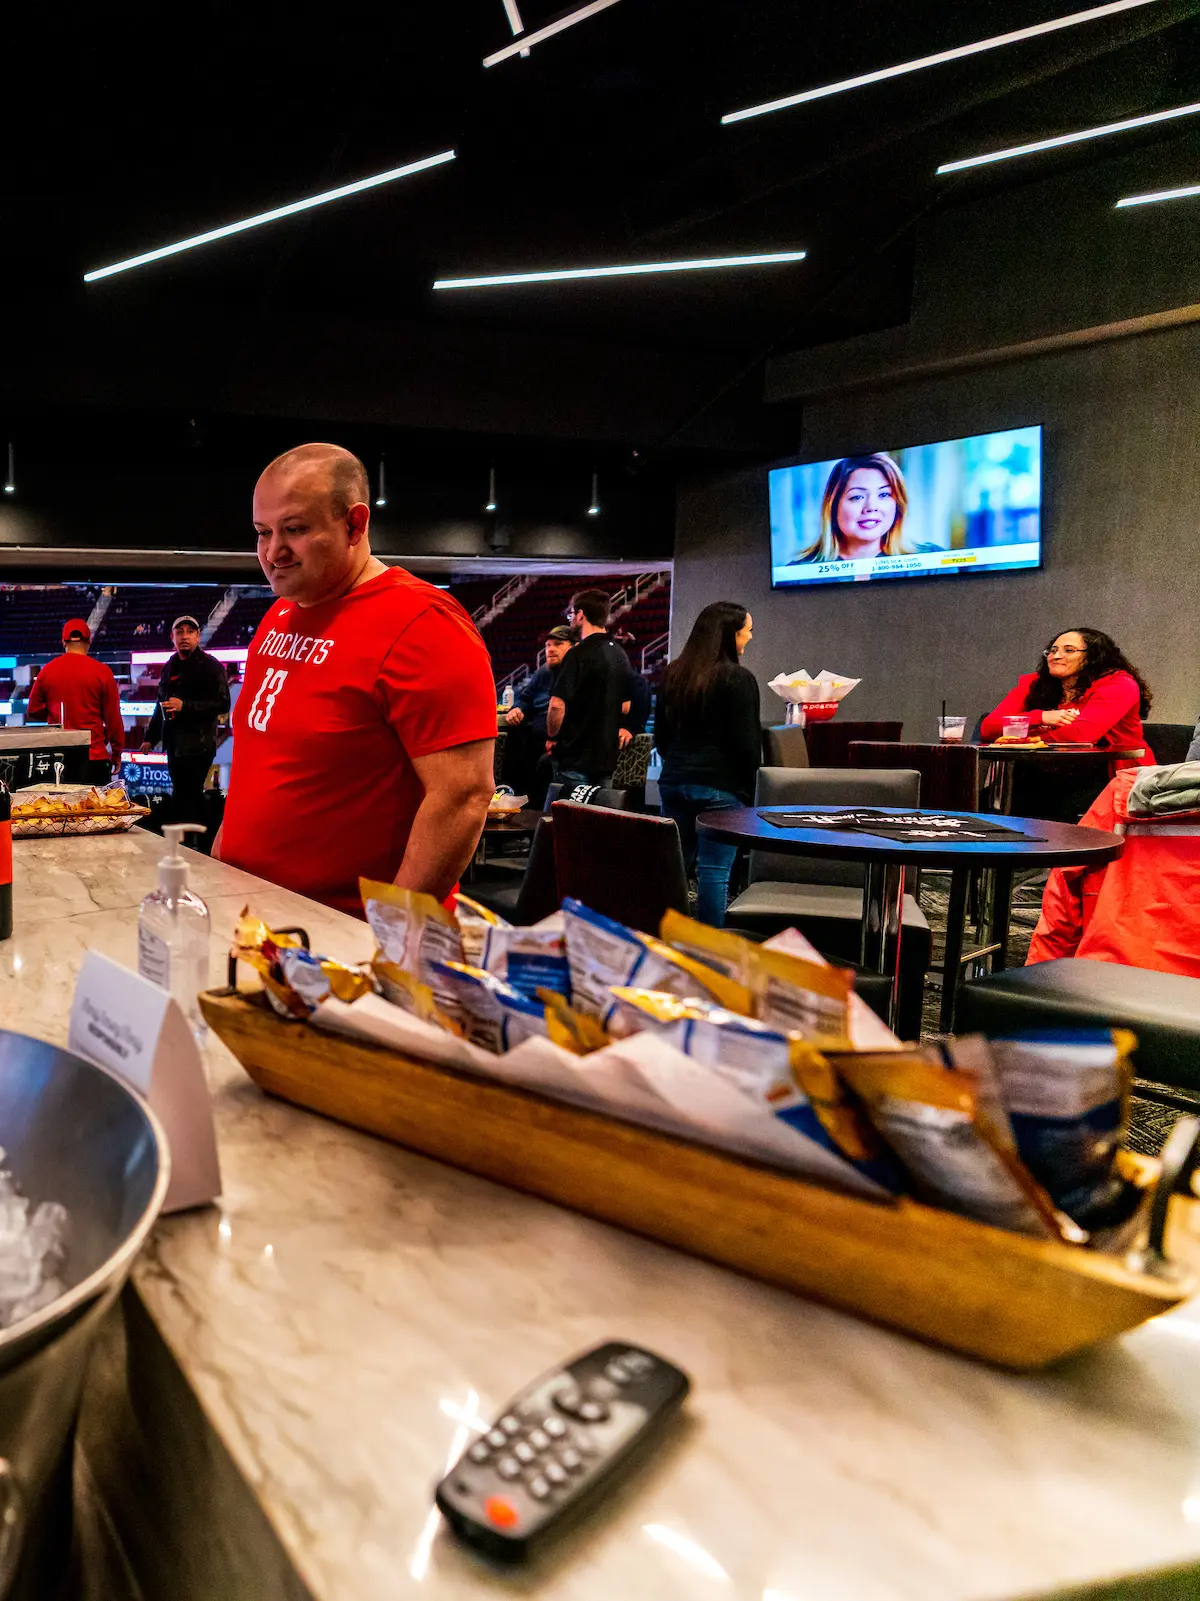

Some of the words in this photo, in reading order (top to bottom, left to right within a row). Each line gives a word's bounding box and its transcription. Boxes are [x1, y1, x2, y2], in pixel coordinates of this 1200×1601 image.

[818, 564, 840, 573] 25%
[257, 627, 335, 665] ROCKETS
[247, 667, 289, 733] 13
